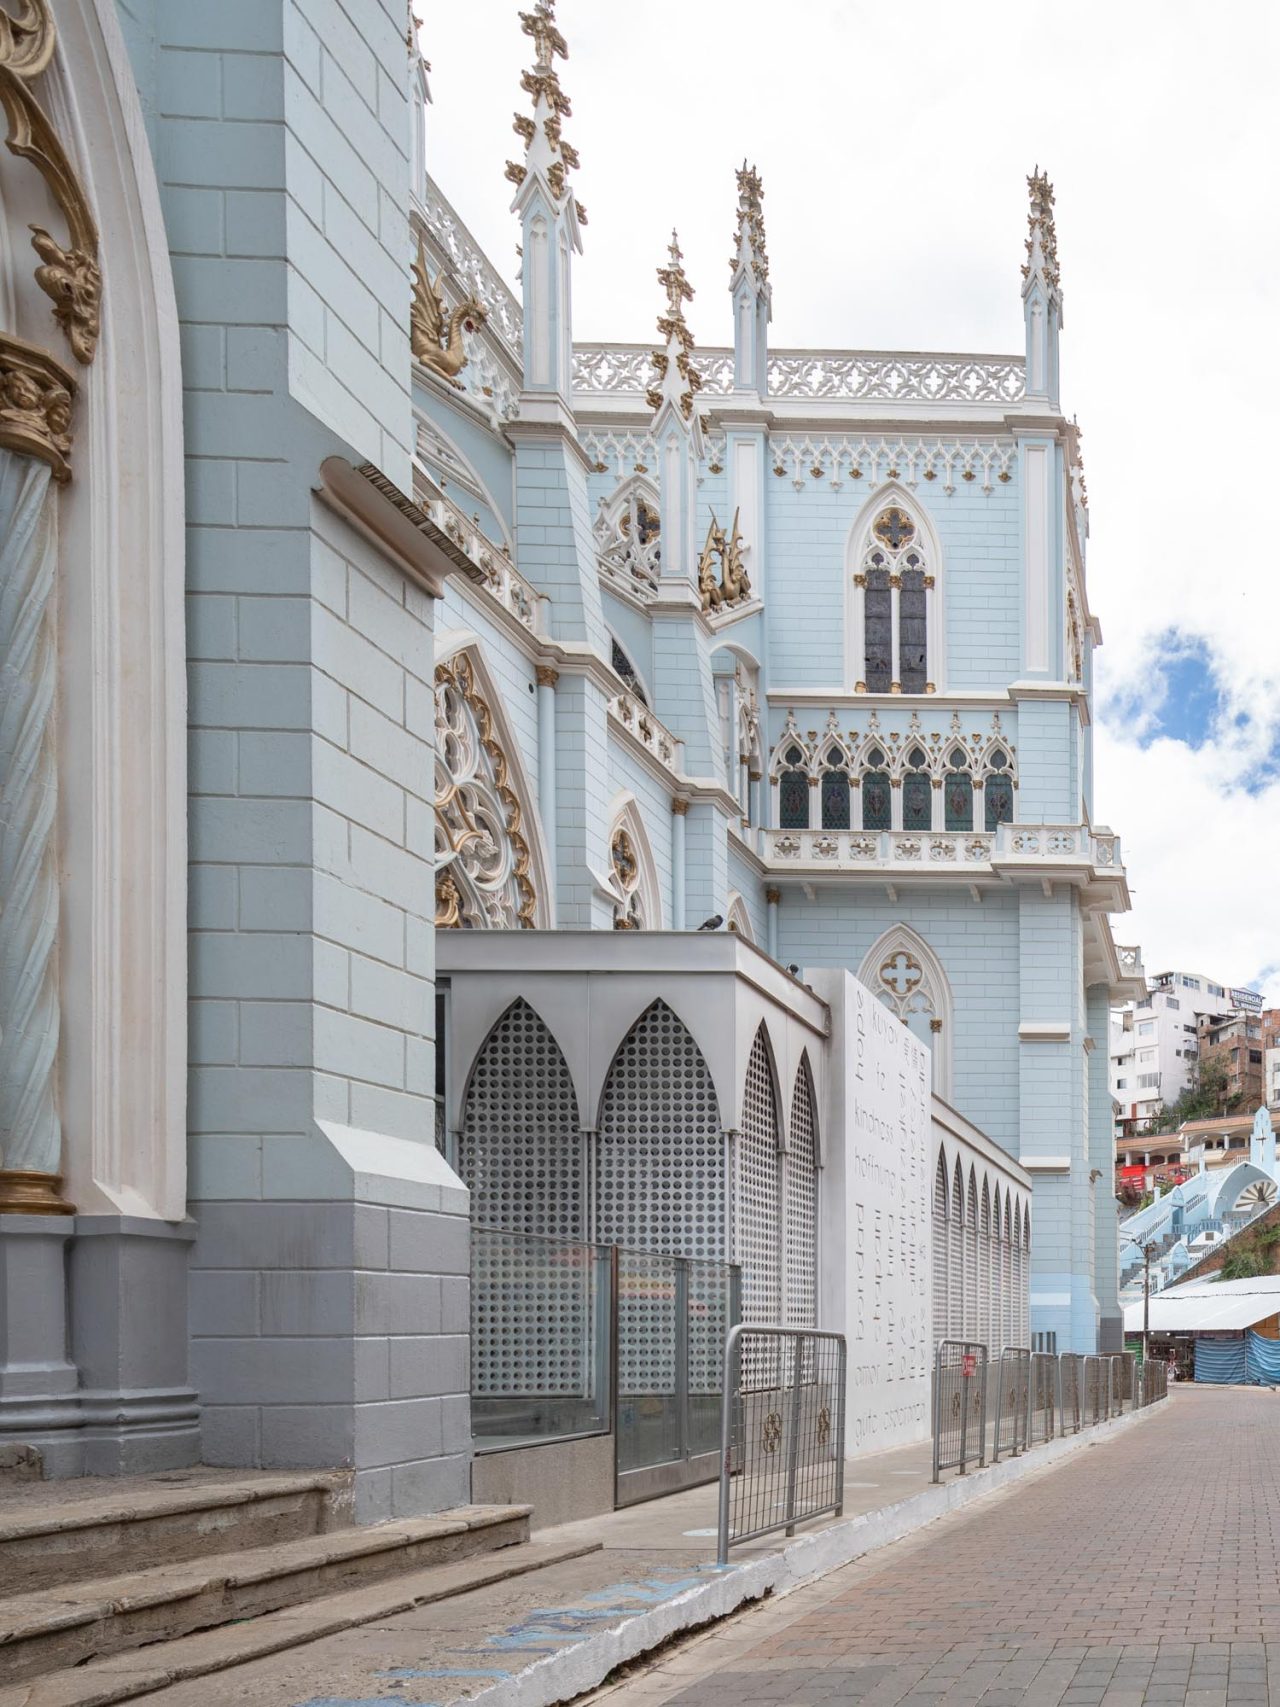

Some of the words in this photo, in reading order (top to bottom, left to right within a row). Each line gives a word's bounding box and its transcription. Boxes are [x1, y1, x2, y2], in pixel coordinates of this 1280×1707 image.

[855, 990, 866, 1081] hope
[855, 1096, 894, 1145] kindness
[855, 1145, 896, 1198] hoffnung
[855, 1202, 865, 1341] bondad
[855, 1364, 881, 1387] amor
